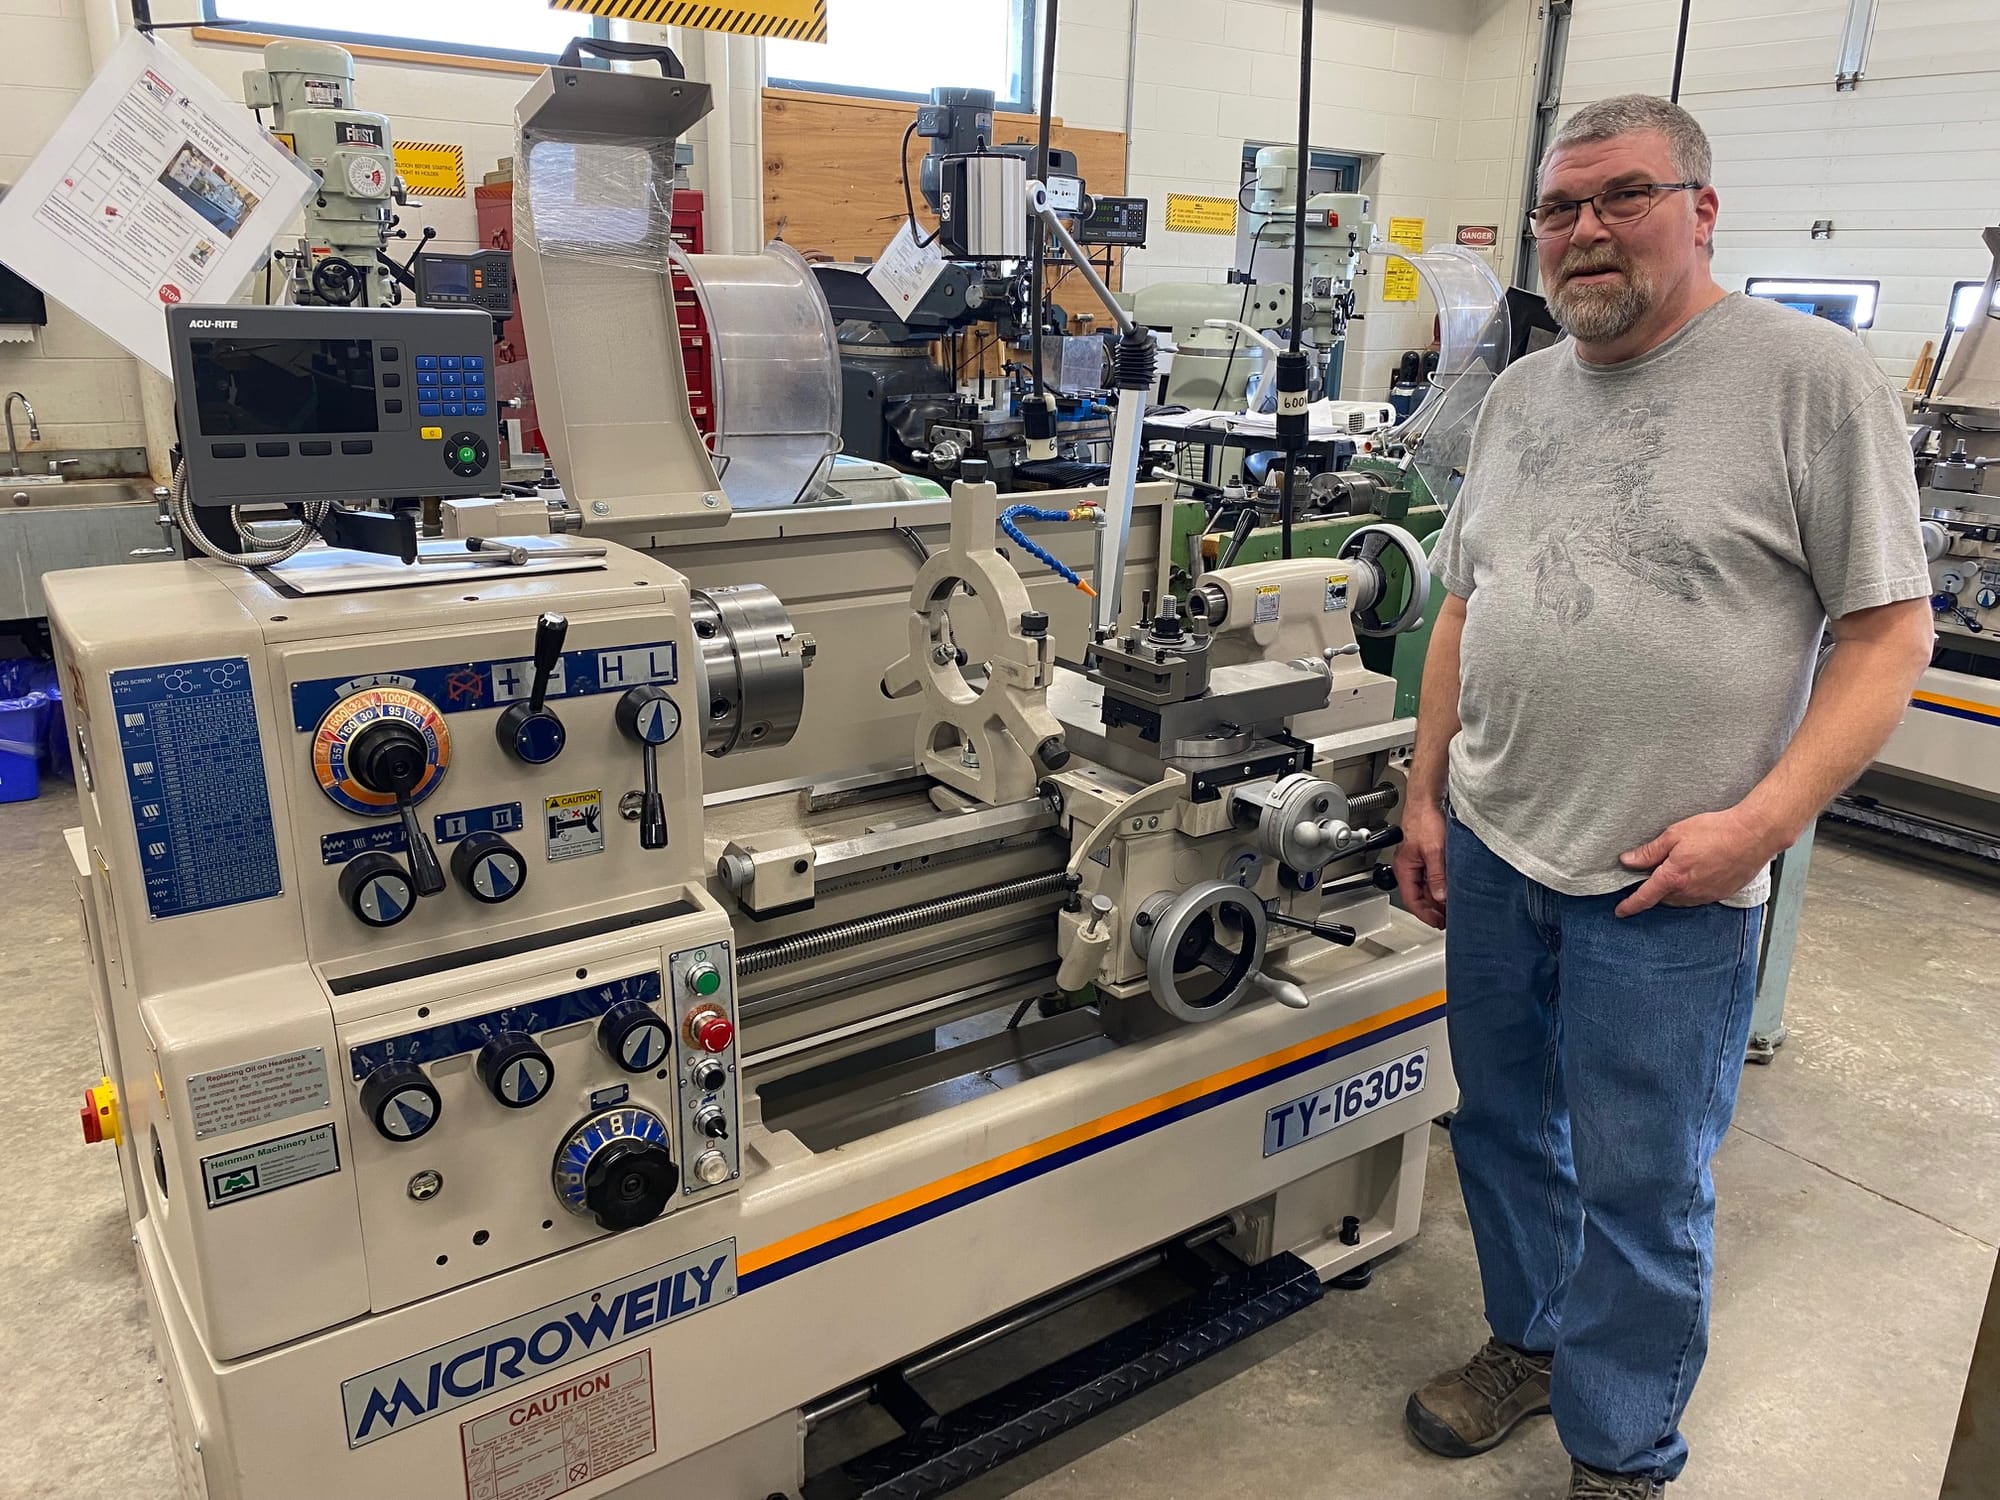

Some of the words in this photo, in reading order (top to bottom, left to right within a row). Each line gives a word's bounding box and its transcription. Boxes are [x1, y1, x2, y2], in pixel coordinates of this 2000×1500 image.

[178, 117, 203, 139] METAL
[199, 134, 222, 155] LATHE
[1461, 231, 1492, 240] DANGER
[160, 286, 180, 303] STOP
[189, 320, 238, 329] ACU-RITE
[1283, 397, 1306, 408] 600
[602, 655, 624, 683] H
[649, 652, 669, 677] L
[129, 677, 152, 685] SCREW
[351, 682, 360, 690] L
[390, 676, 400, 684] H
[328, 708, 348, 730] 1600
[384, 693, 407, 704] 1000
[332, 746, 342, 761] 55
[339, 720, 357, 739] 160
[360, 710, 374, 721] 30
[388, 707, 401, 716] 95
[409, 710, 422, 725] 70
[561, 792, 596, 806] CAUTION
[600, 990, 614, 1003] W
[620, 980, 629, 993] X
[638, 980, 648, 993] Y
[479, 1022, 491, 1035] R
[500, 1012, 509, 1026] S
[526, 1012, 539, 1027] T
[360, 1054, 373, 1068] A
[386, 1042, 395, 1056] B
[409, 1040, 420, 1055] C
[206, 1068, 243, 1082] Replacing
[268, 1054, 305, 1067] Headstock
[208, 1078, 239, 1090] necessary
[250, 1069, 273, 1080] replace
[209, 1087, 235, 1098] machine
[238, 1082, 251, 1090] after
[261, 1075, 283, 1085] months
[194, 1102, 210, 1110] once
[212, 1097, 229, 1106] every
[240, 1089, 262, 1099] months
[196, 1108, 218, 1118] Ensure
[220, 1104, 232, 1112] that
[248, 1093, 277, 1105] headstock
[288, 1087, 302, 1095] filled
[1271, 1054, 1424, 1148] TY-1630S
[197, 1118, 212, 1127] level
[237, 1106, 260, 1116] relevant
[199, 1125, 216, 1134] ellus
[239, 1114, 260, 1124] SHELL
[609, 1114, 625, 1135] 8
[210, 1151, 254, 1170] Heinman
[257, 1136, 307, 1158] Machinery
[309, 1130, 328, 1142] Ltd.
[355, 1254, 729, 1440] MICROWEILY
[508, 1371, 610, 1429] CAUTION
[470, 1445, 480, 1454] Be
[483, 1438, 497, 1448] sure
[510, 1427, 525, 1437] read
[527, 1416, 550, 1430] manual
[553, 1406, 573, 1419] before
[576, 1394, 605, 1410] operating
[607, 1388, 619, 1396] this
